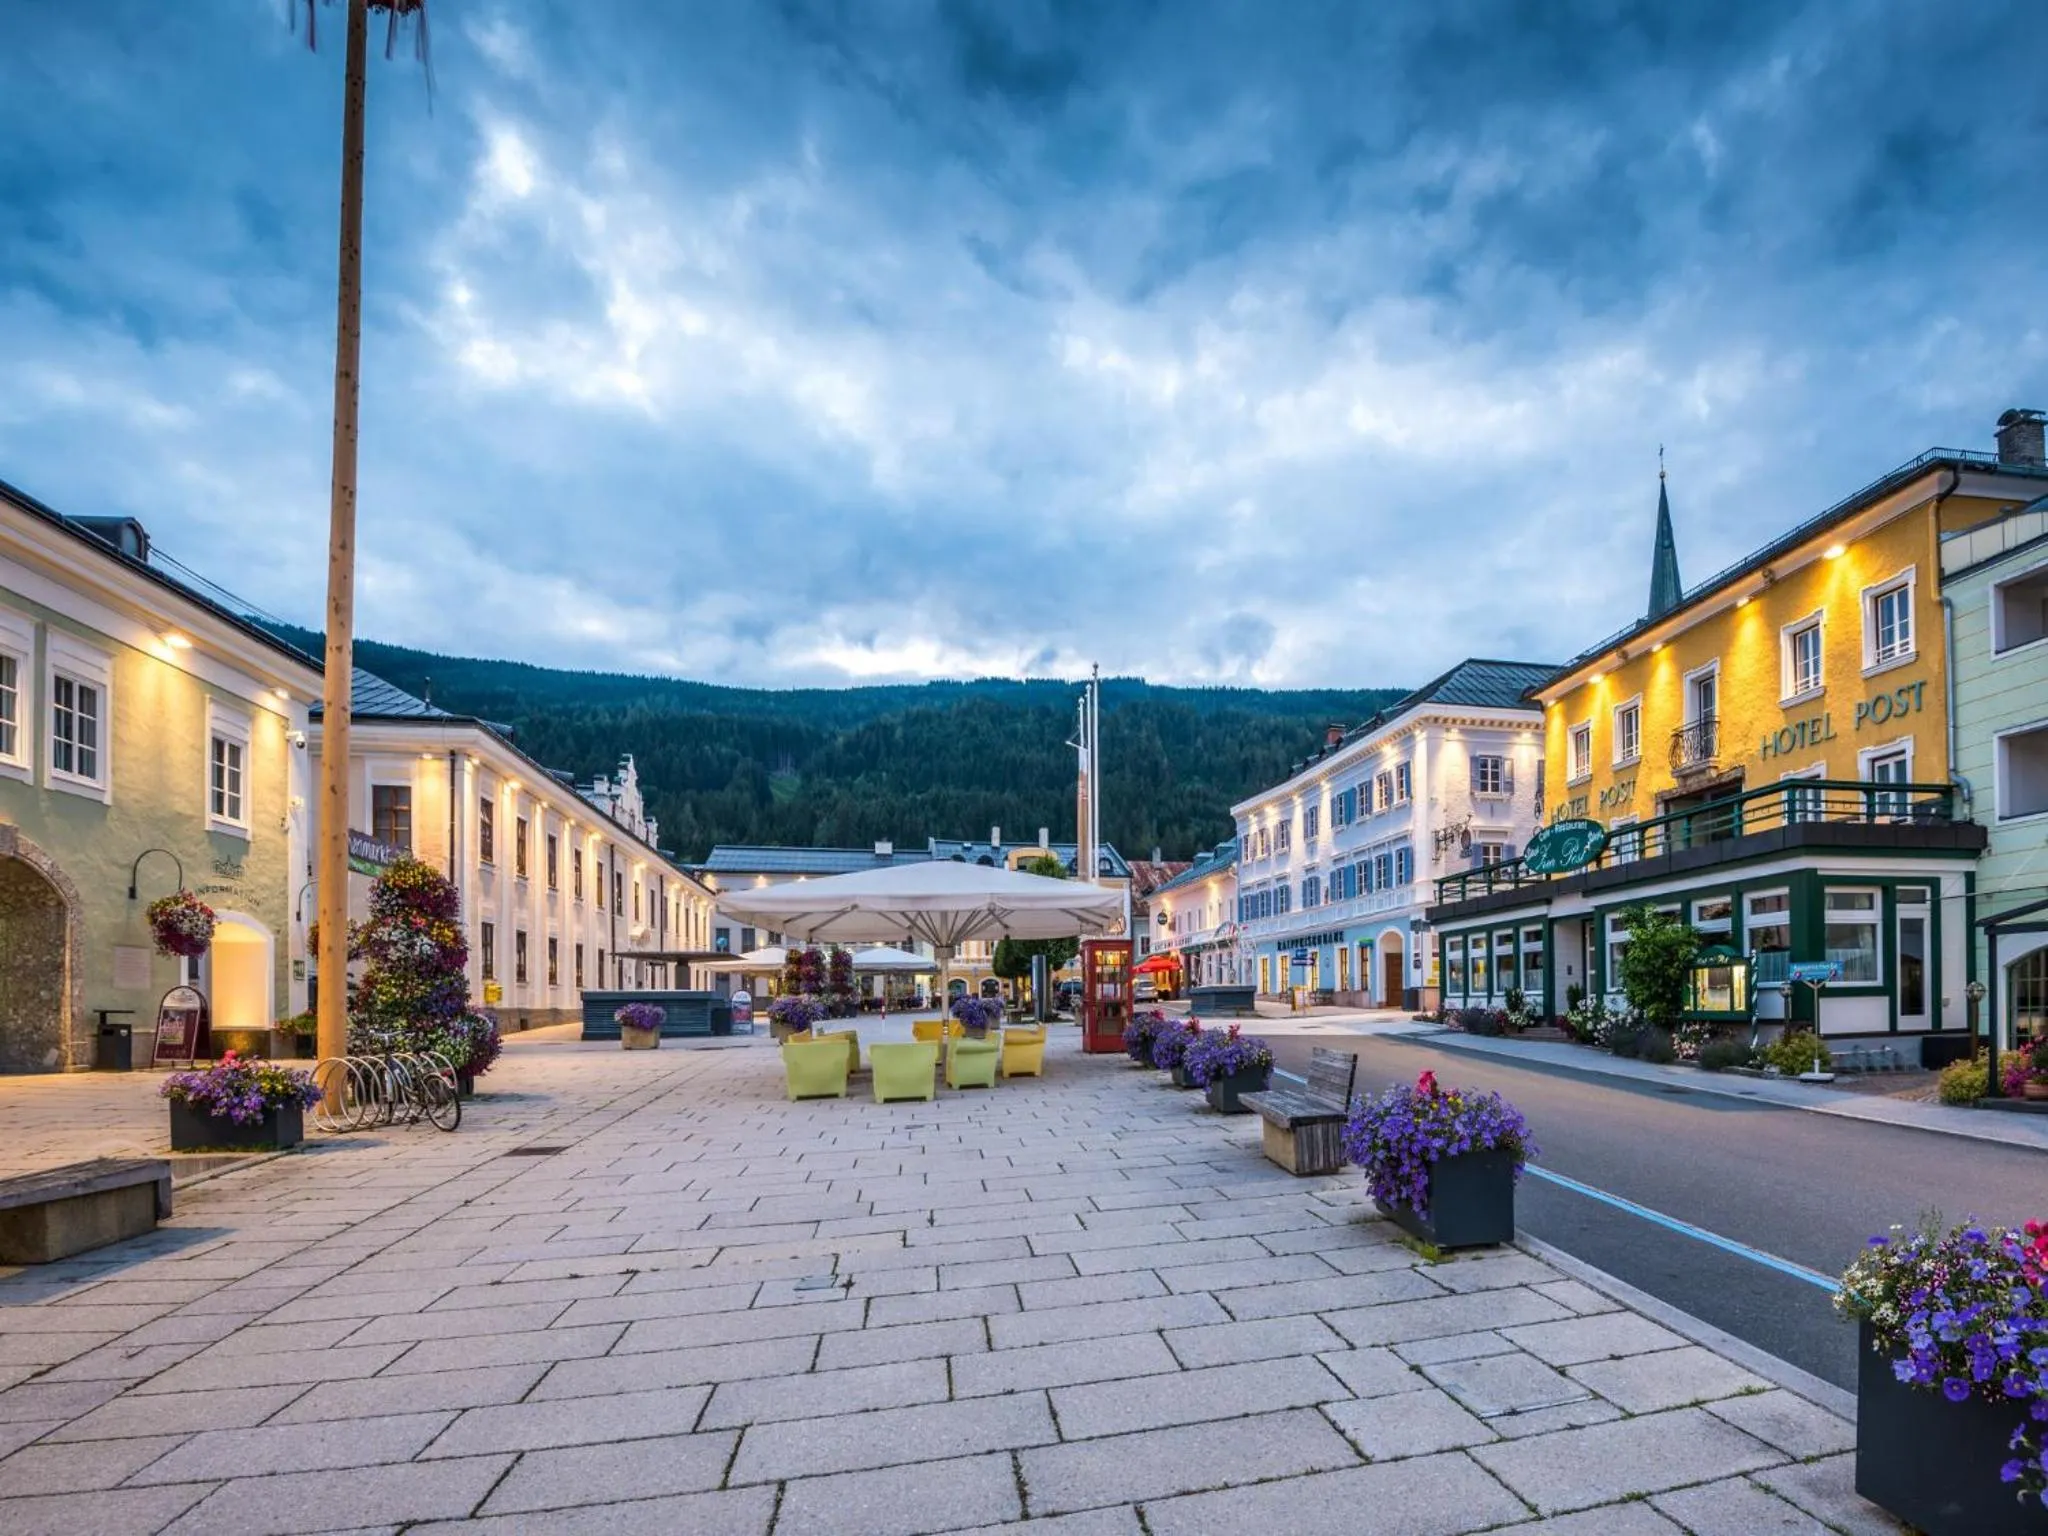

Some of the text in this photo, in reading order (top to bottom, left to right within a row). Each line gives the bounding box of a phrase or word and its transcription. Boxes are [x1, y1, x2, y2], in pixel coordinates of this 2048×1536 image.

[1759, 679, 1927, 761] HOTEL POST
[1551, 777, 1637, 823] HOTEL POST
